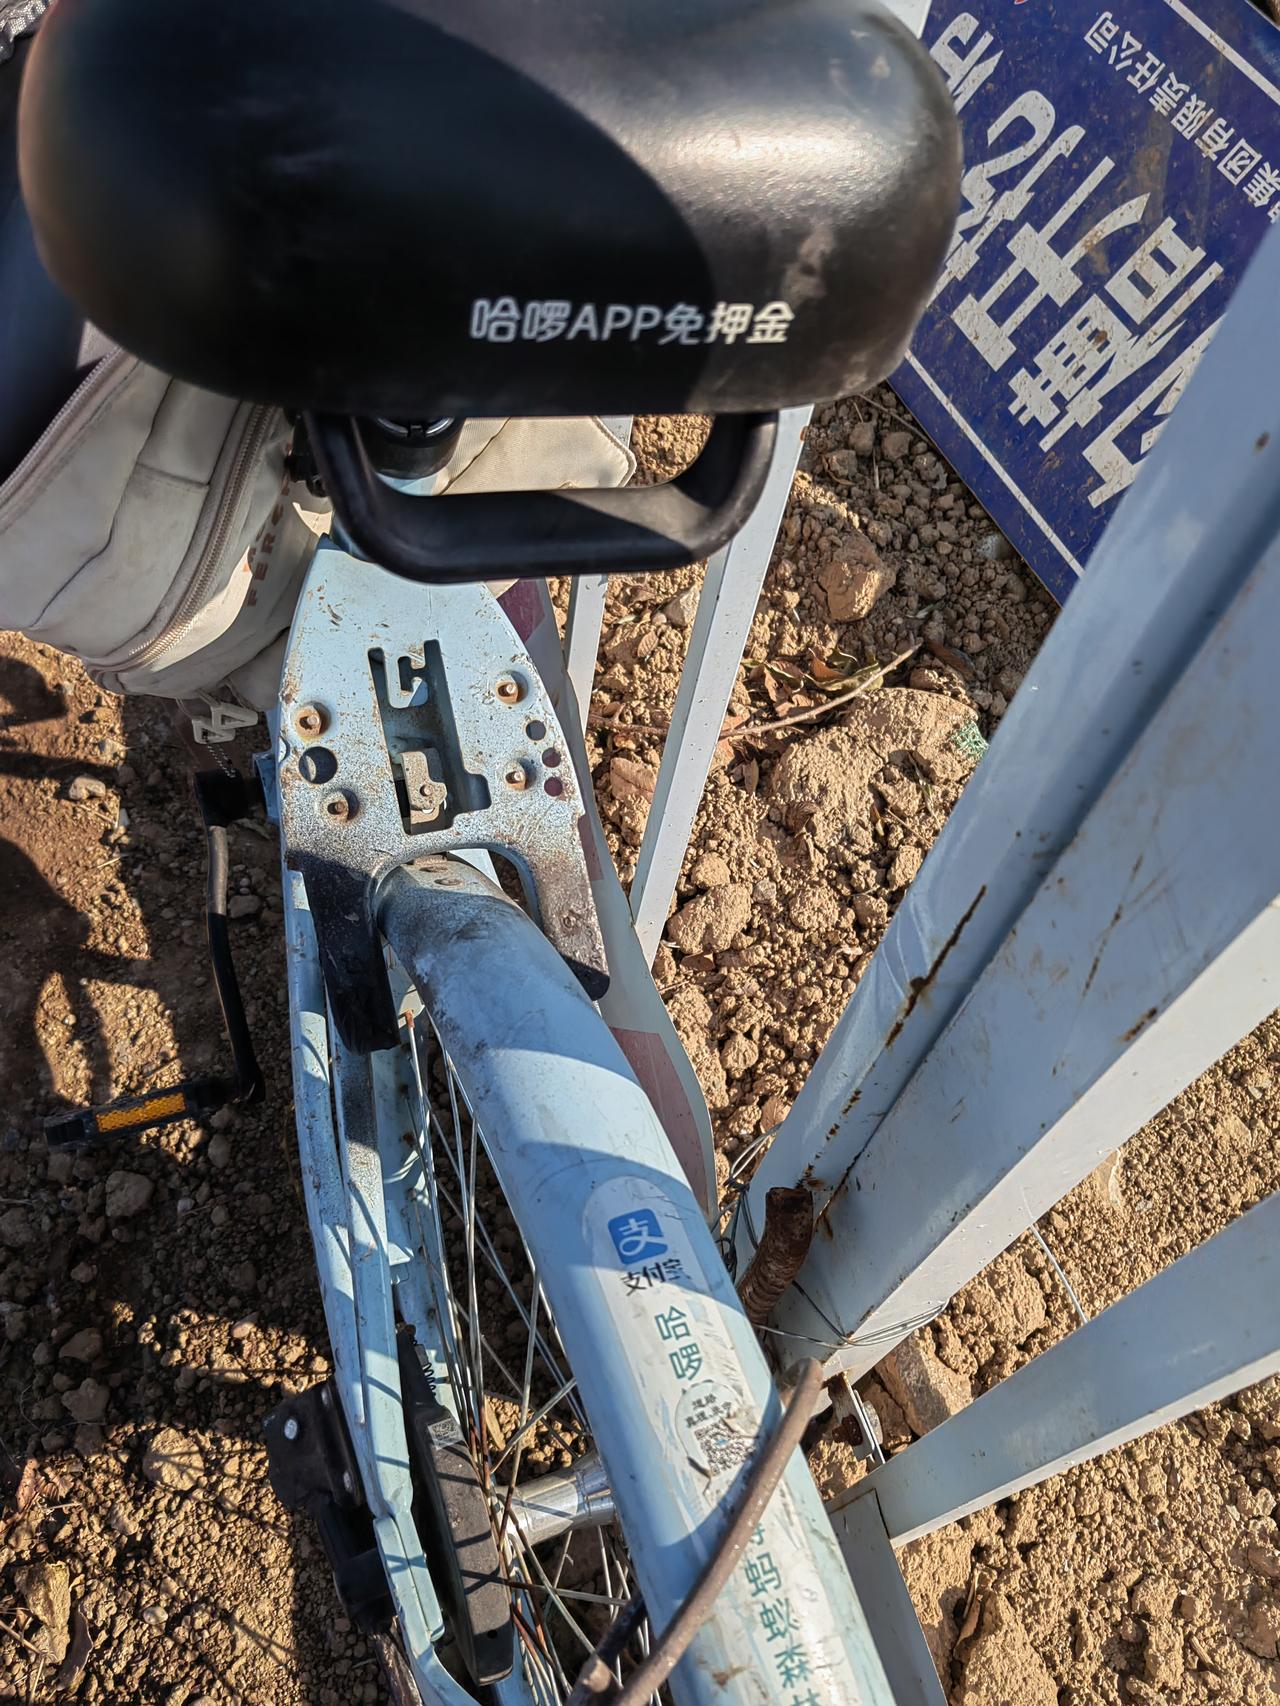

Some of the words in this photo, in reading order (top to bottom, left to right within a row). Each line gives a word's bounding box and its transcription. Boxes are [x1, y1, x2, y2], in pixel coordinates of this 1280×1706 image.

[470, 296, 795, 345] 哈啰APP免押金
